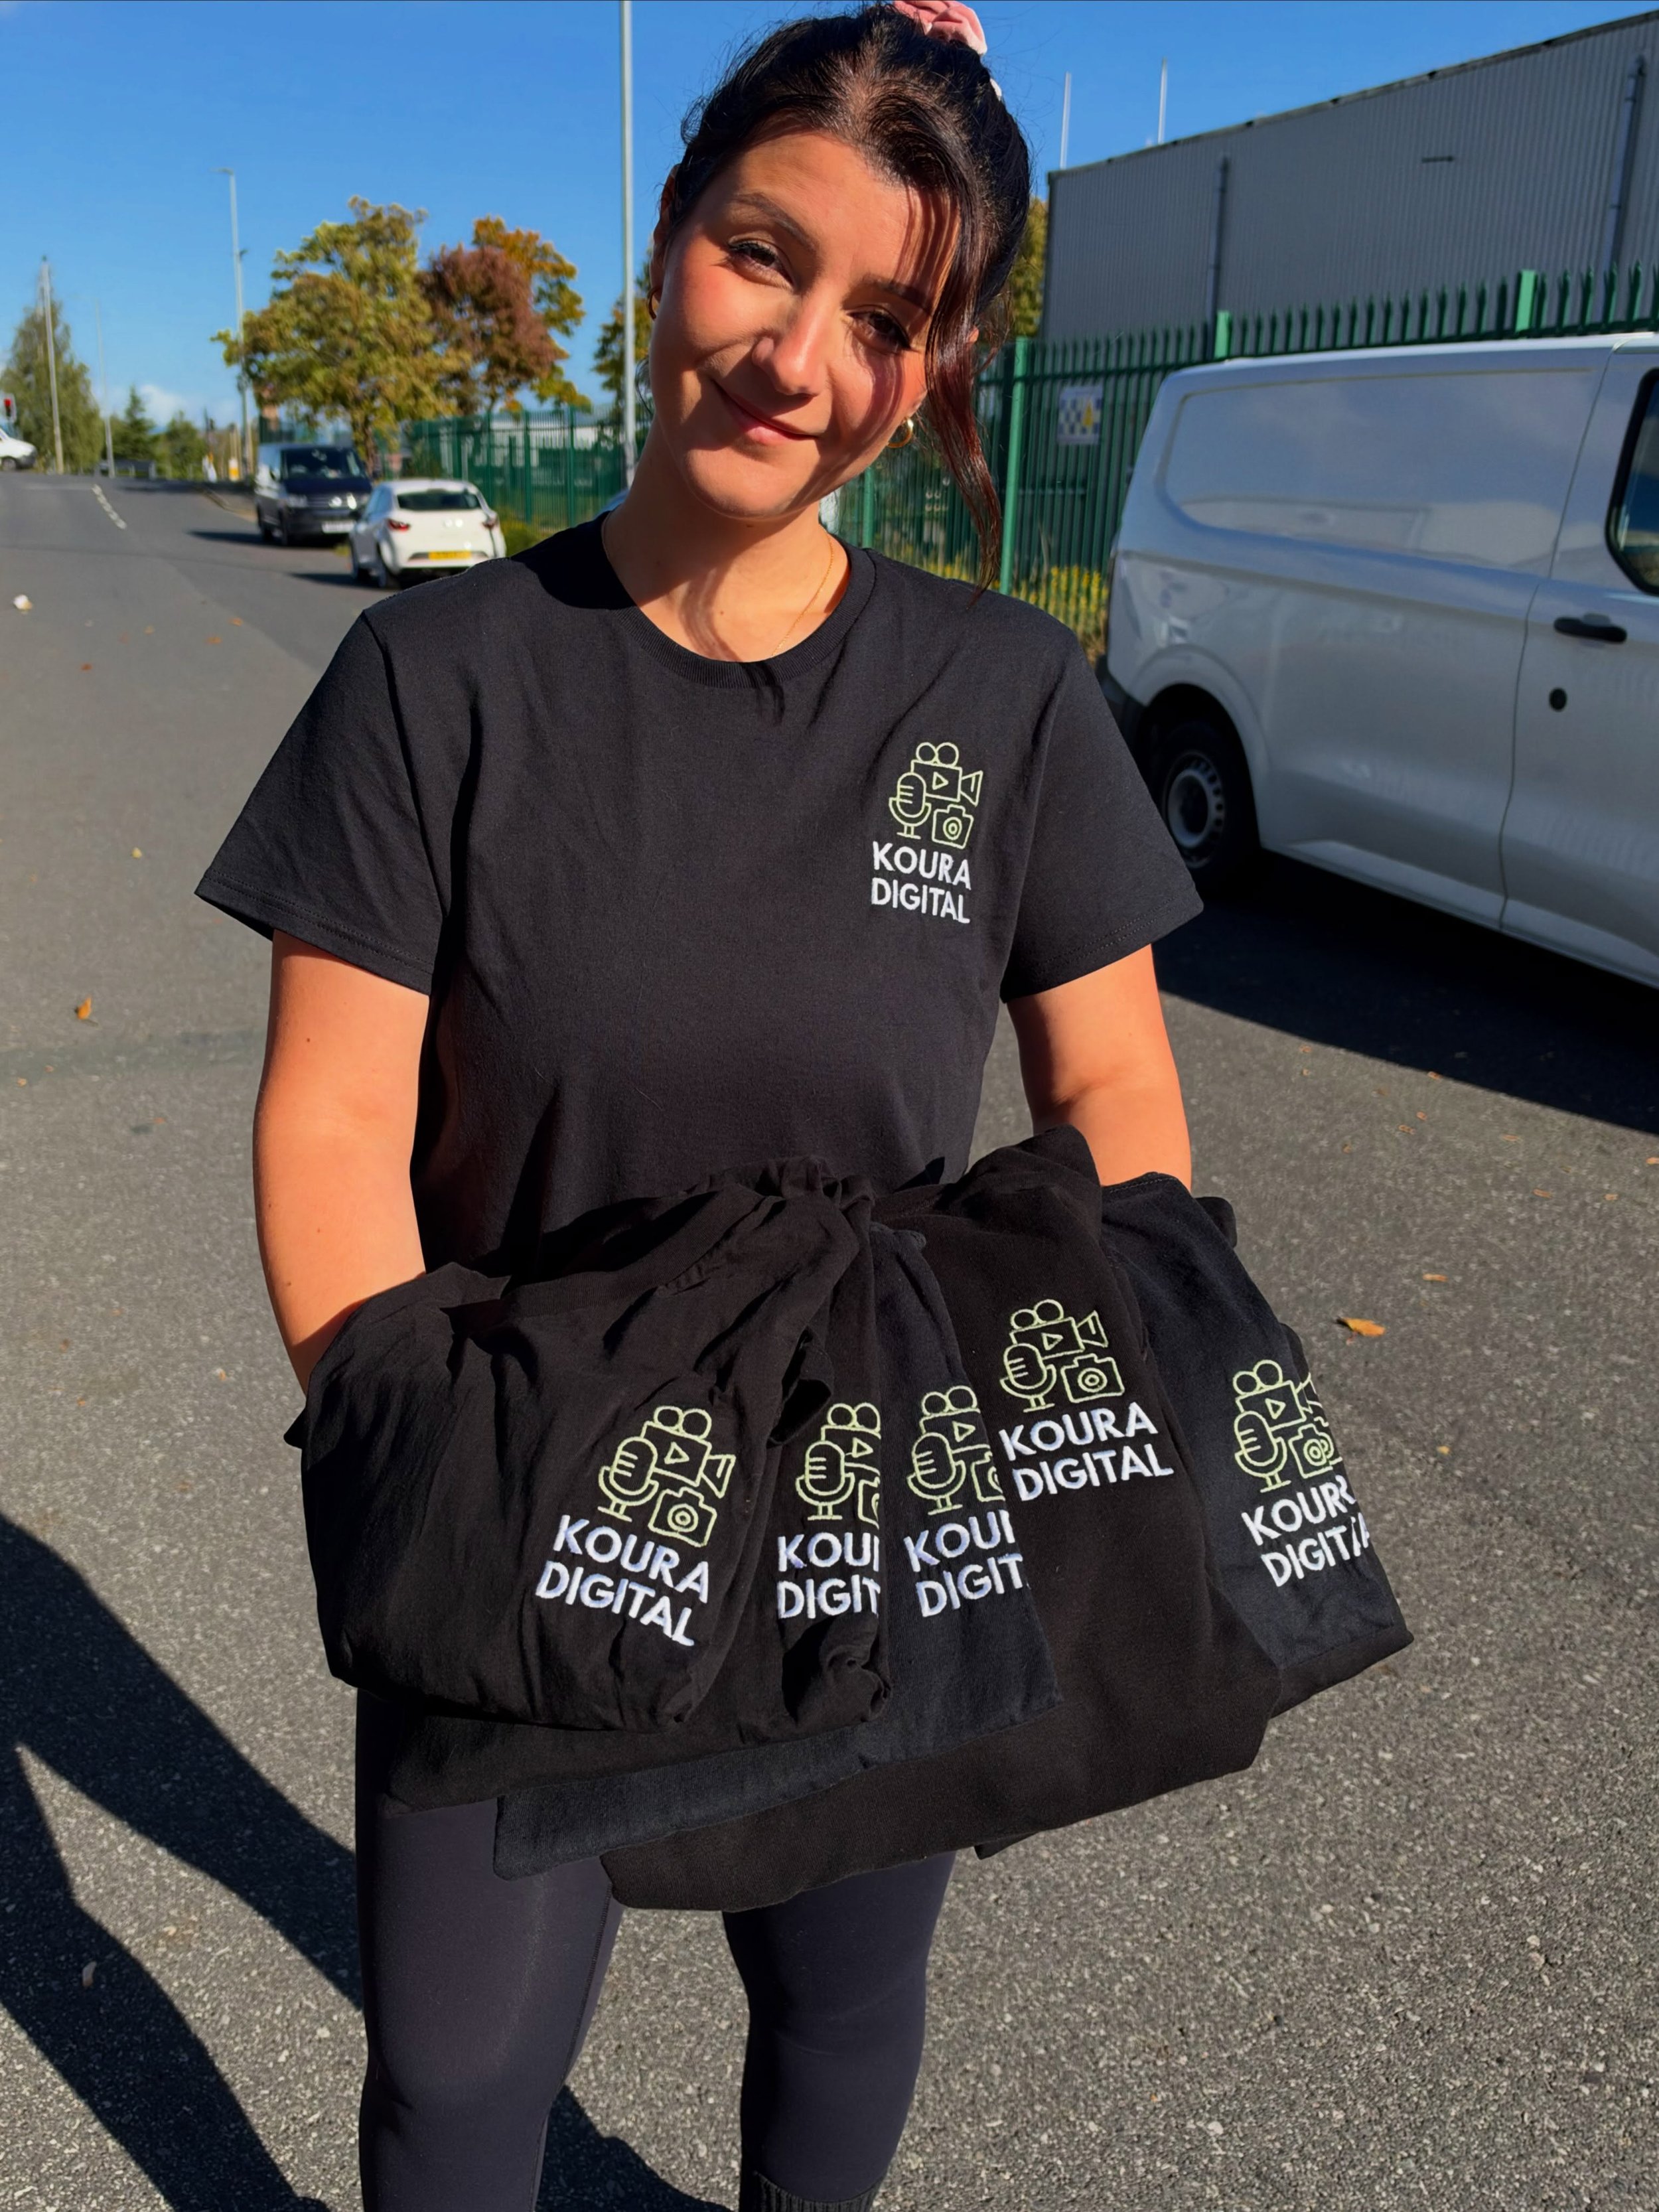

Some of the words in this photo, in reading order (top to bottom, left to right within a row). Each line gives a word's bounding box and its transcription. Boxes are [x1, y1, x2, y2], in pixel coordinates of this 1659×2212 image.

[873, 841, 971, 890] KOURA
[871, 877, 970, 923] DIGITAL
[999, 1402, 1158, 1461] KOURA
[1013, 1443, 1174, 1501] DIGITAL
[553, 1515, 708, 1603] KOURA
[536, 1561, 694, 1646] DIGITAL
